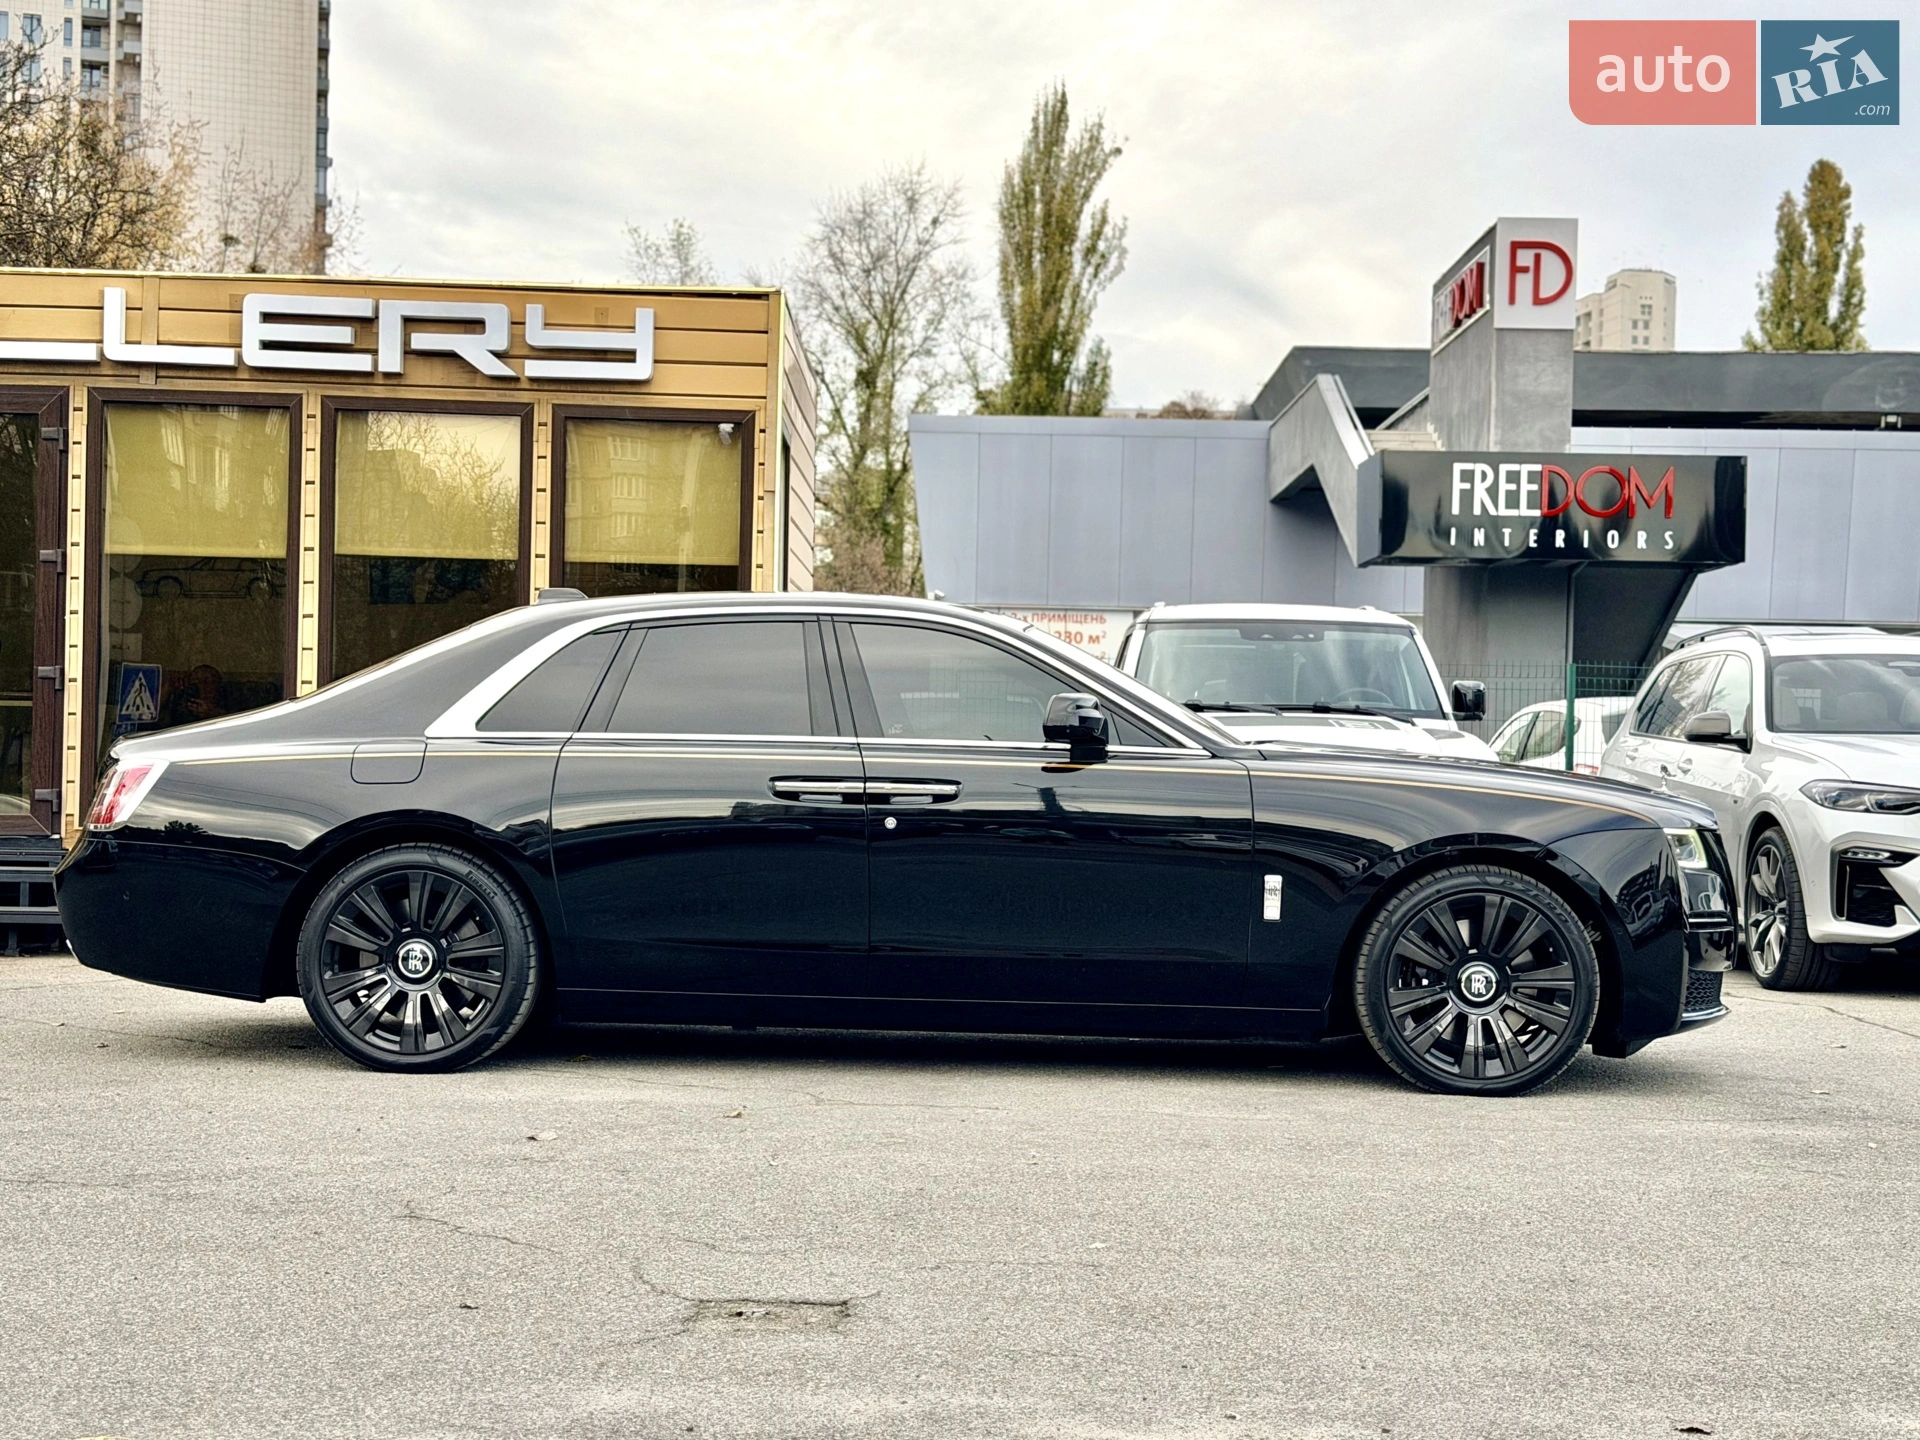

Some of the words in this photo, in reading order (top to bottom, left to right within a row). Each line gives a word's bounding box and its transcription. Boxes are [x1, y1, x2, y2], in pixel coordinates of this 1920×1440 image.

[1508, 240, 1574, 306] FD
[0, 286, 655, 382] LERY
[1451, 462, 1675, 519] FREEDOM
[1450, 527, 1674, 550] INTERIORS
[1031, 612, 1107, 625] ПРИМІЩЕНЬ
